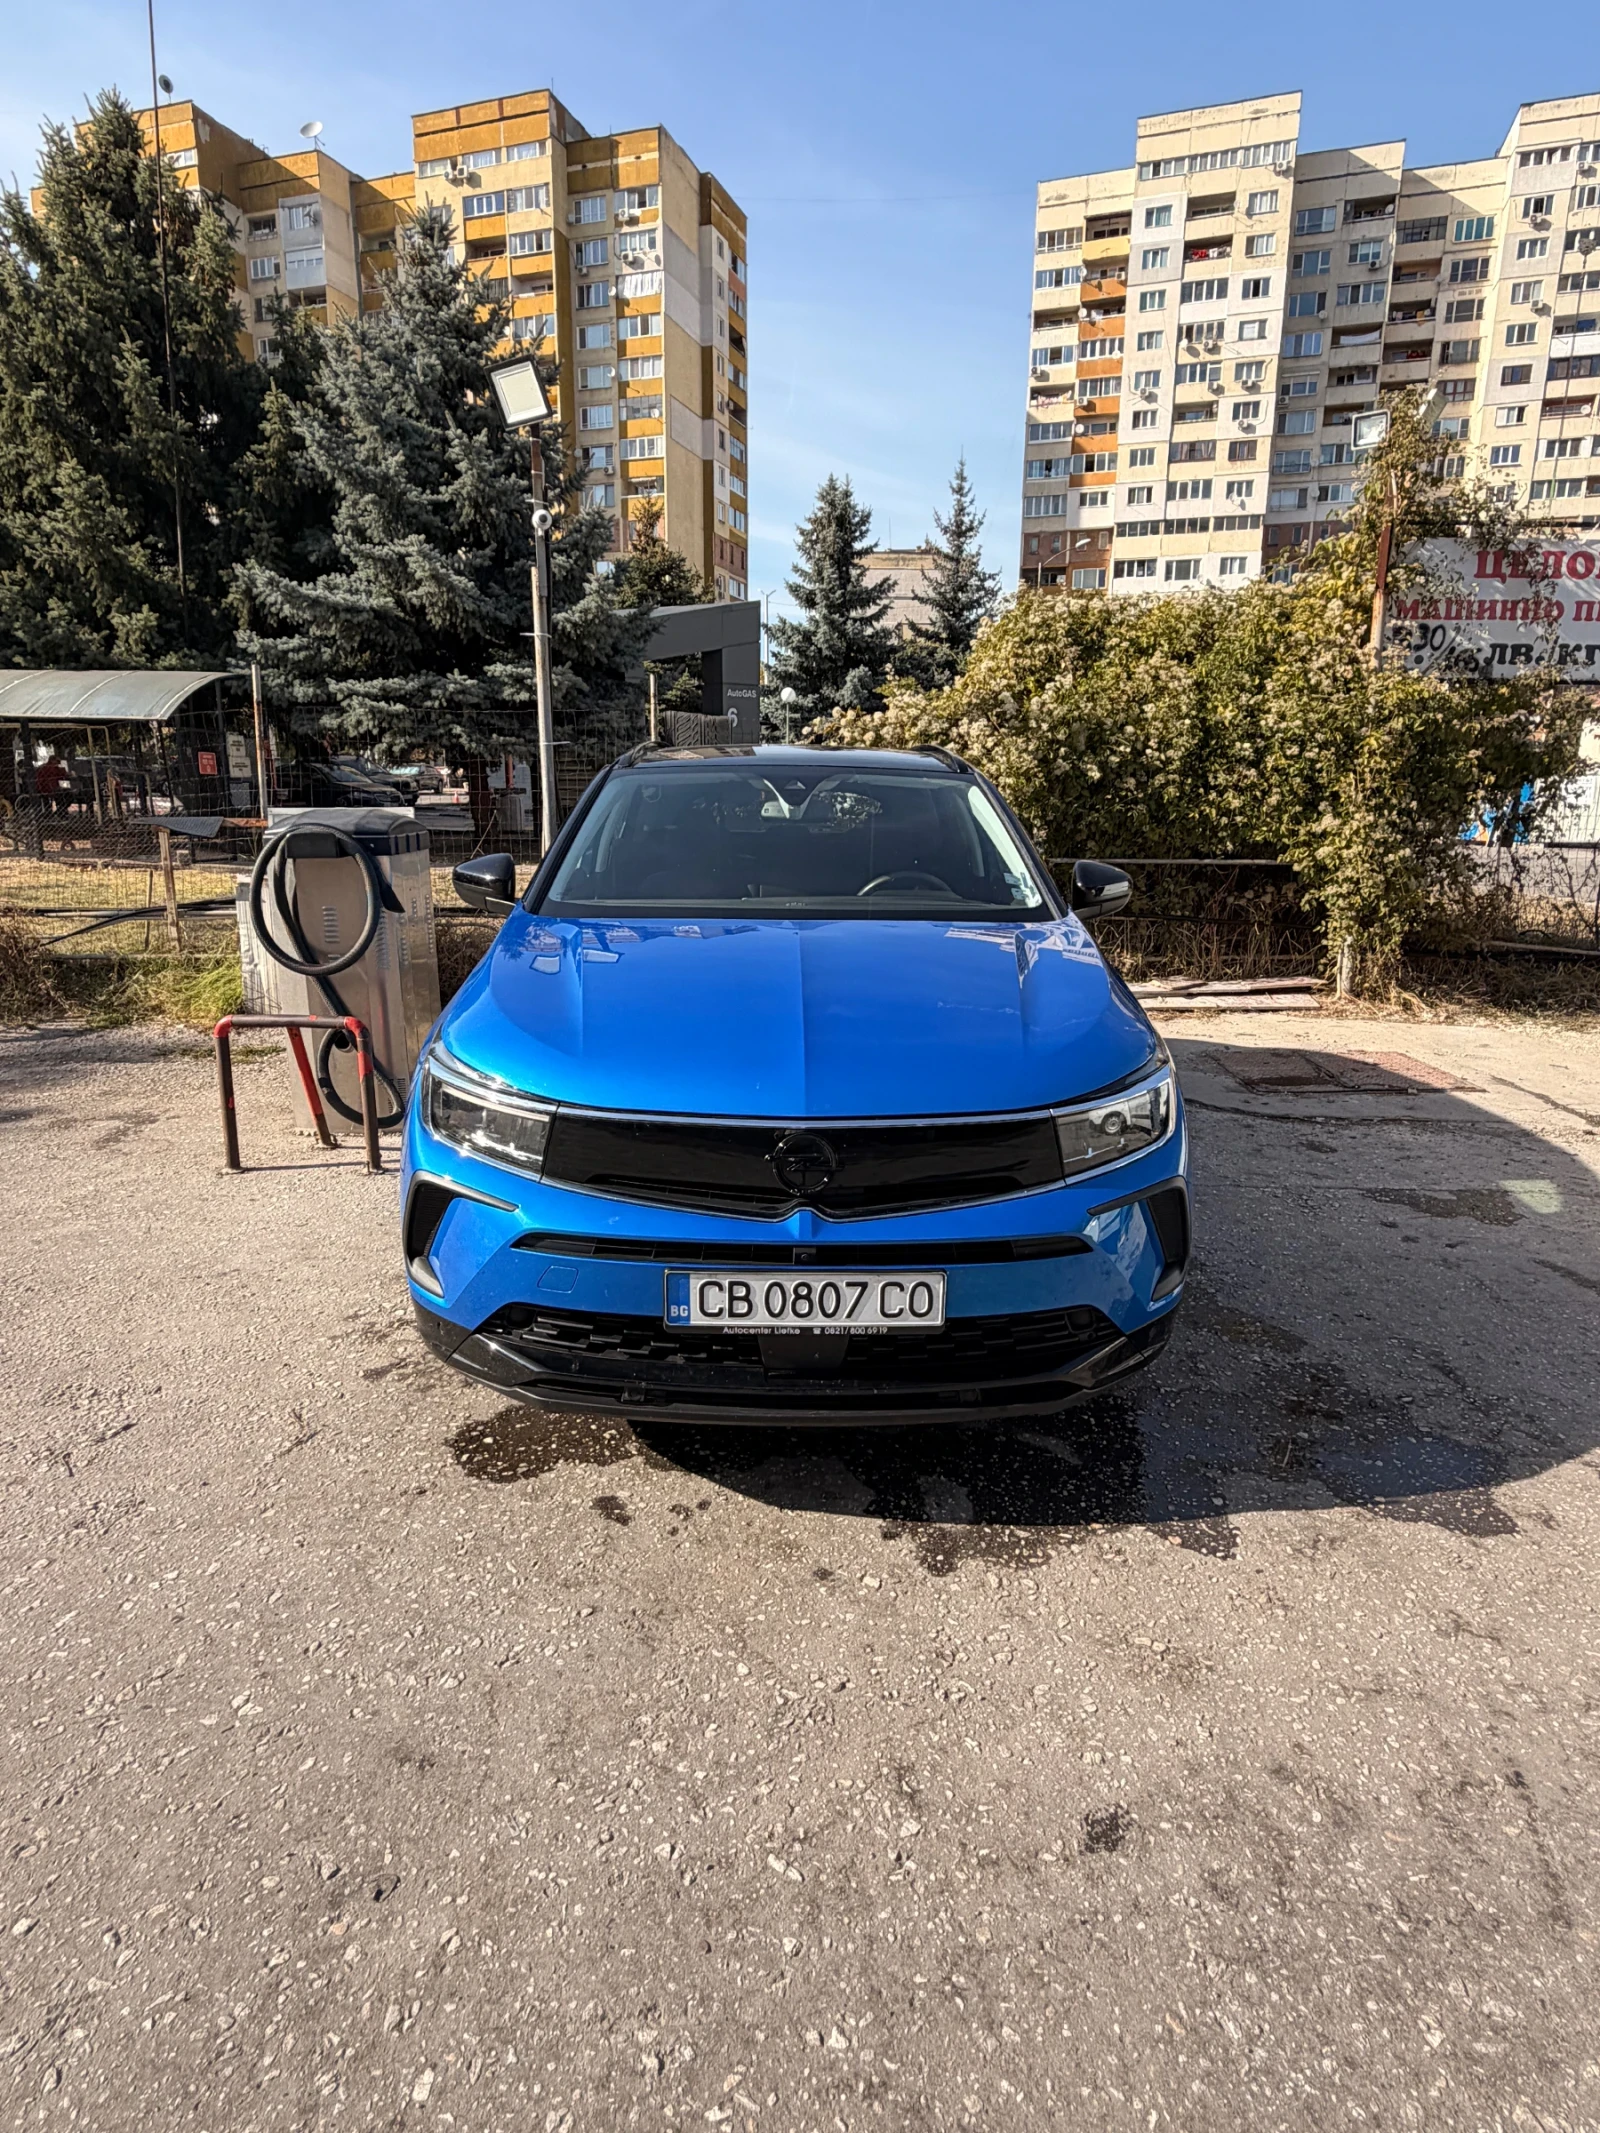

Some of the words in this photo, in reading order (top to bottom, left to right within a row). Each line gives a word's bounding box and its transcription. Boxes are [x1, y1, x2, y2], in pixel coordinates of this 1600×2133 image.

[1474, 550, 1600, 584] ЦЕЛО
[727, 688, 757, 698] AutoGAS
[727, 707, 738, 728] 6
[670, 1305, 688, 1317] BG
[698, 1280, 753, 1318] CB
[764, 1281, 868, 1318] 0807
[722, 1326, 772, 1334] Autocenter
[774, 1326, 801, 1334] Liefke
